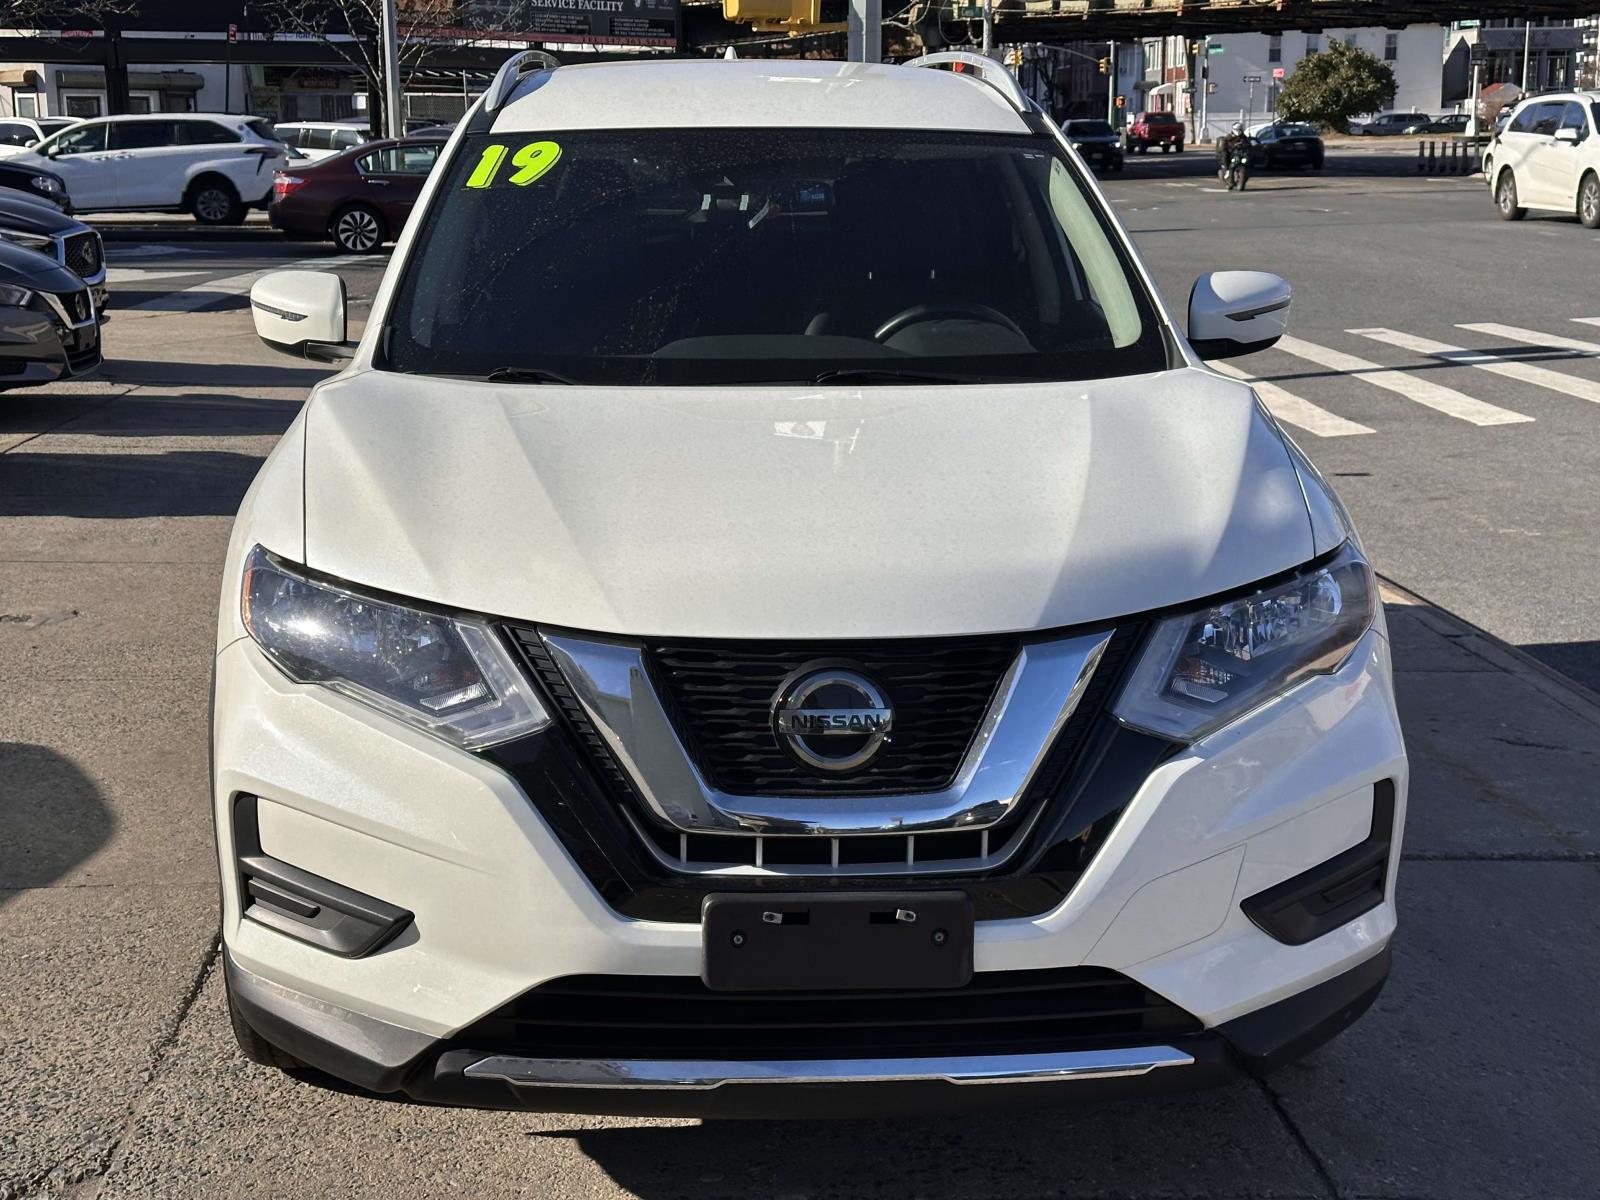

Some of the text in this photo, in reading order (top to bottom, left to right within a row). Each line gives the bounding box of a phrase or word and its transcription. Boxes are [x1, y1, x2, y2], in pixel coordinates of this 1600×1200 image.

[531, 0, 624, 11] SERVICE FACILITY
[466, 141, 562, 188] 19
[791, 713, 880, 729] NISSAN
